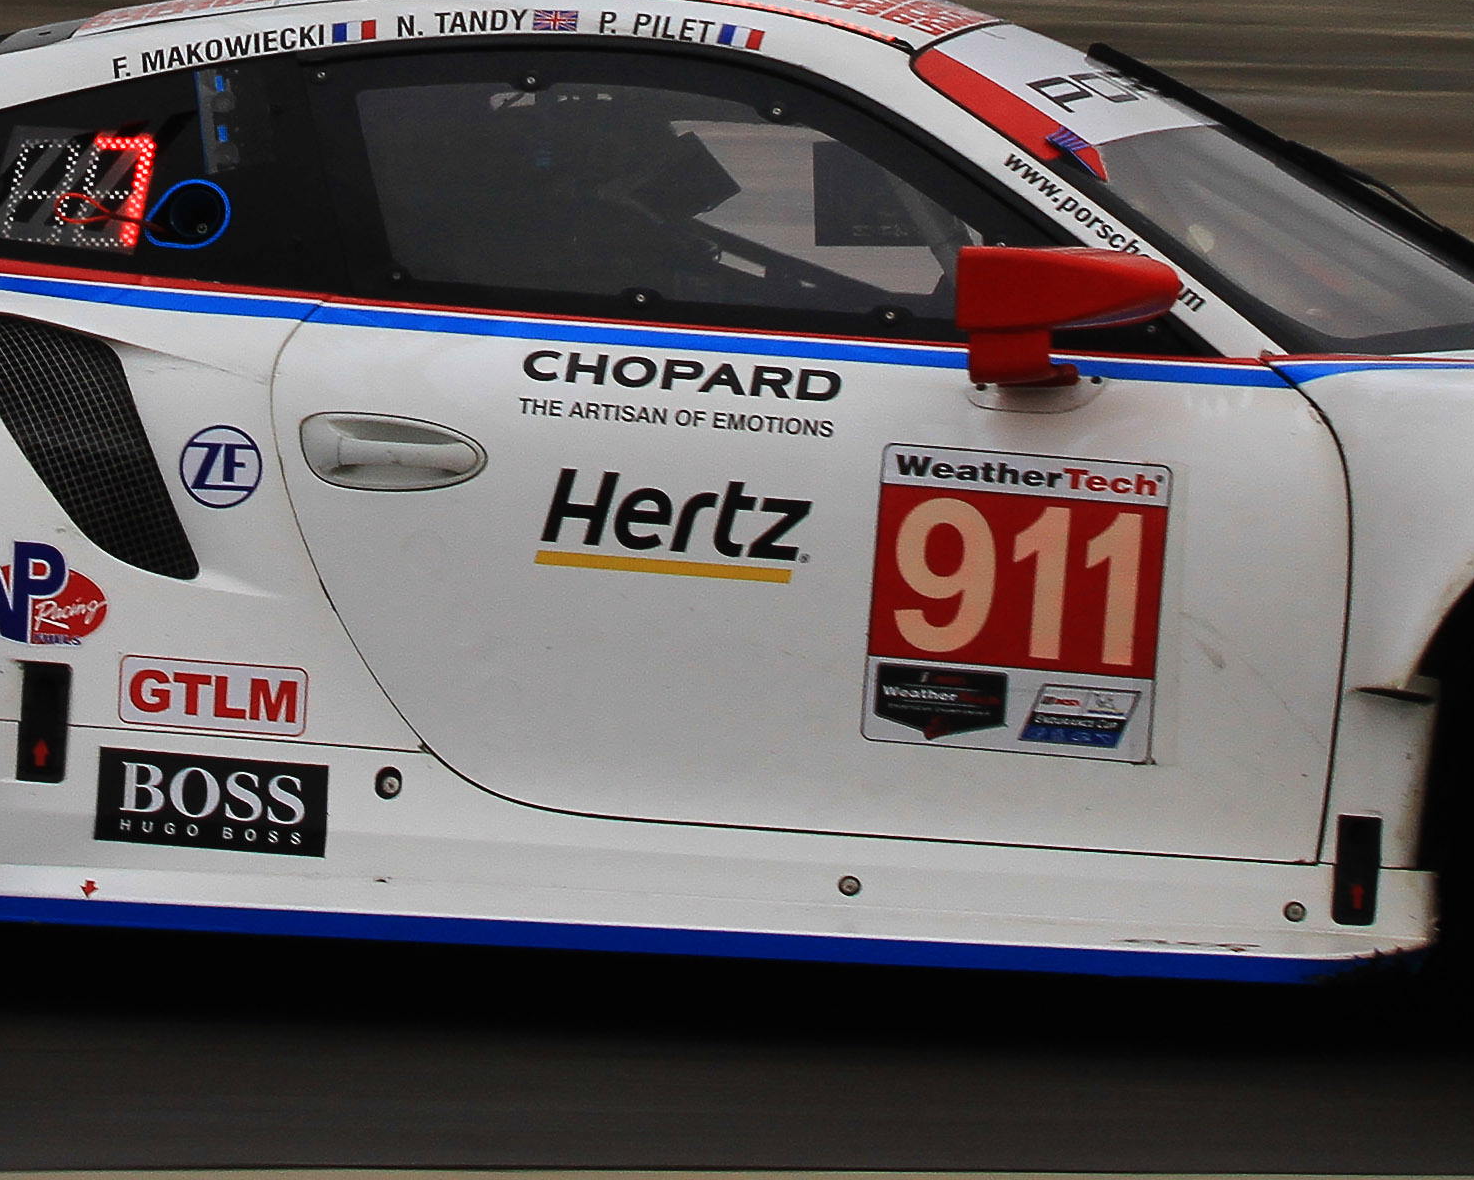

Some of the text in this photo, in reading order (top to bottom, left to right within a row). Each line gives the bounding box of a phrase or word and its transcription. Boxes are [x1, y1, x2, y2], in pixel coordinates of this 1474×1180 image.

[397, 9, 528, 37] N. TANDY
[599, 11, 715, 43] P. PILET
[112, 24, 326, 79] F. MAKOWIECKI
[1003, 153, 1207, 312] www.porschm
[522, 350, 842, 402] CHOPARD
[519, 397, 834, 438] THE ARTISAN OF EMOTIONS
[187, 441, 257, 491] ZF
[895, 453, 1165, 497] WeatherTech
[540, 467, 813, 563] Hertz
[893, 497, 1144, 666] 911
[34, 599, 108, 631] Racing
[129, 669, 298, 723] GTLM
[119, 761, 306, 825] BOSS
[120, 818, 302, 846] HUGO BOSS
